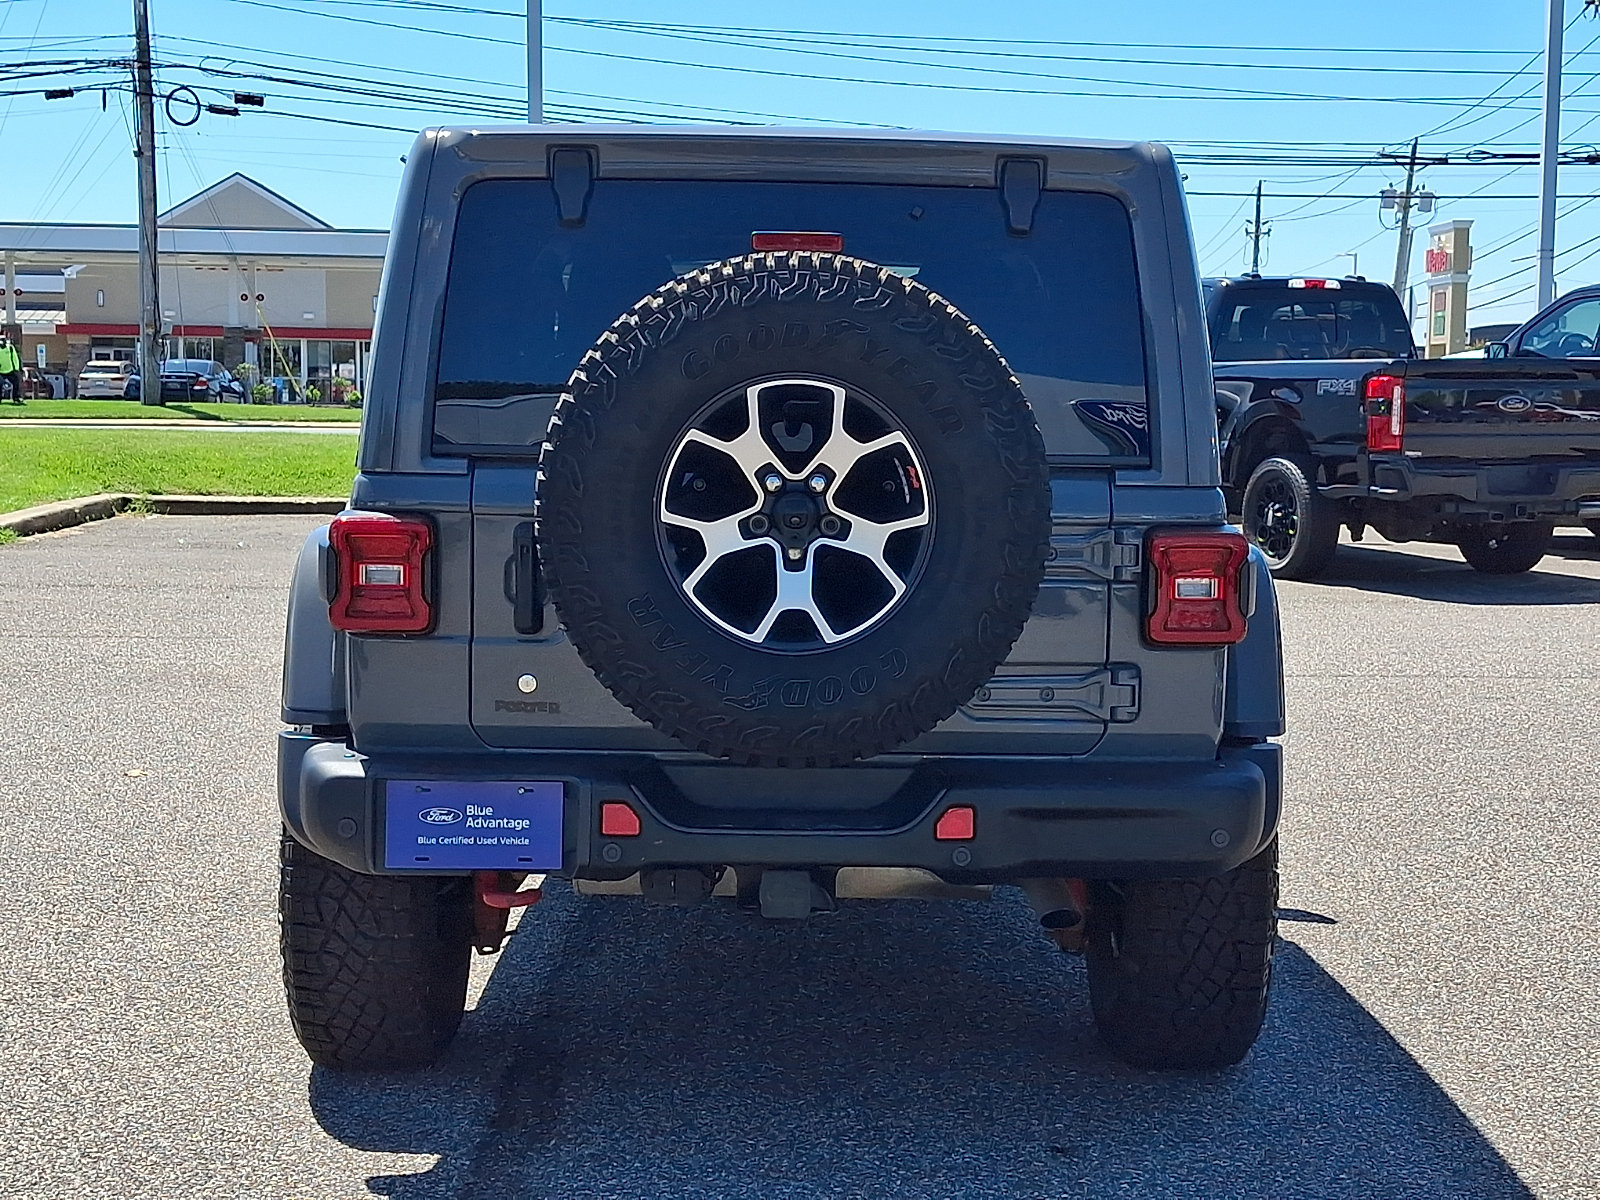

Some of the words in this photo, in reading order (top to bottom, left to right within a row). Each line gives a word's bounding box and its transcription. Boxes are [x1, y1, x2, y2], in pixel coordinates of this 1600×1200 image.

[1316, 379, 1356, 395] FX4
[466, 804, 494, 816] Blue
[465, 817, 531, 831] Advantage
[417, 836, 437, 845] Blue
[438, 836, 474, 846] Certified
[476, 837, 498, 846] Used
[499, 837, 530, 846] Vehicle
